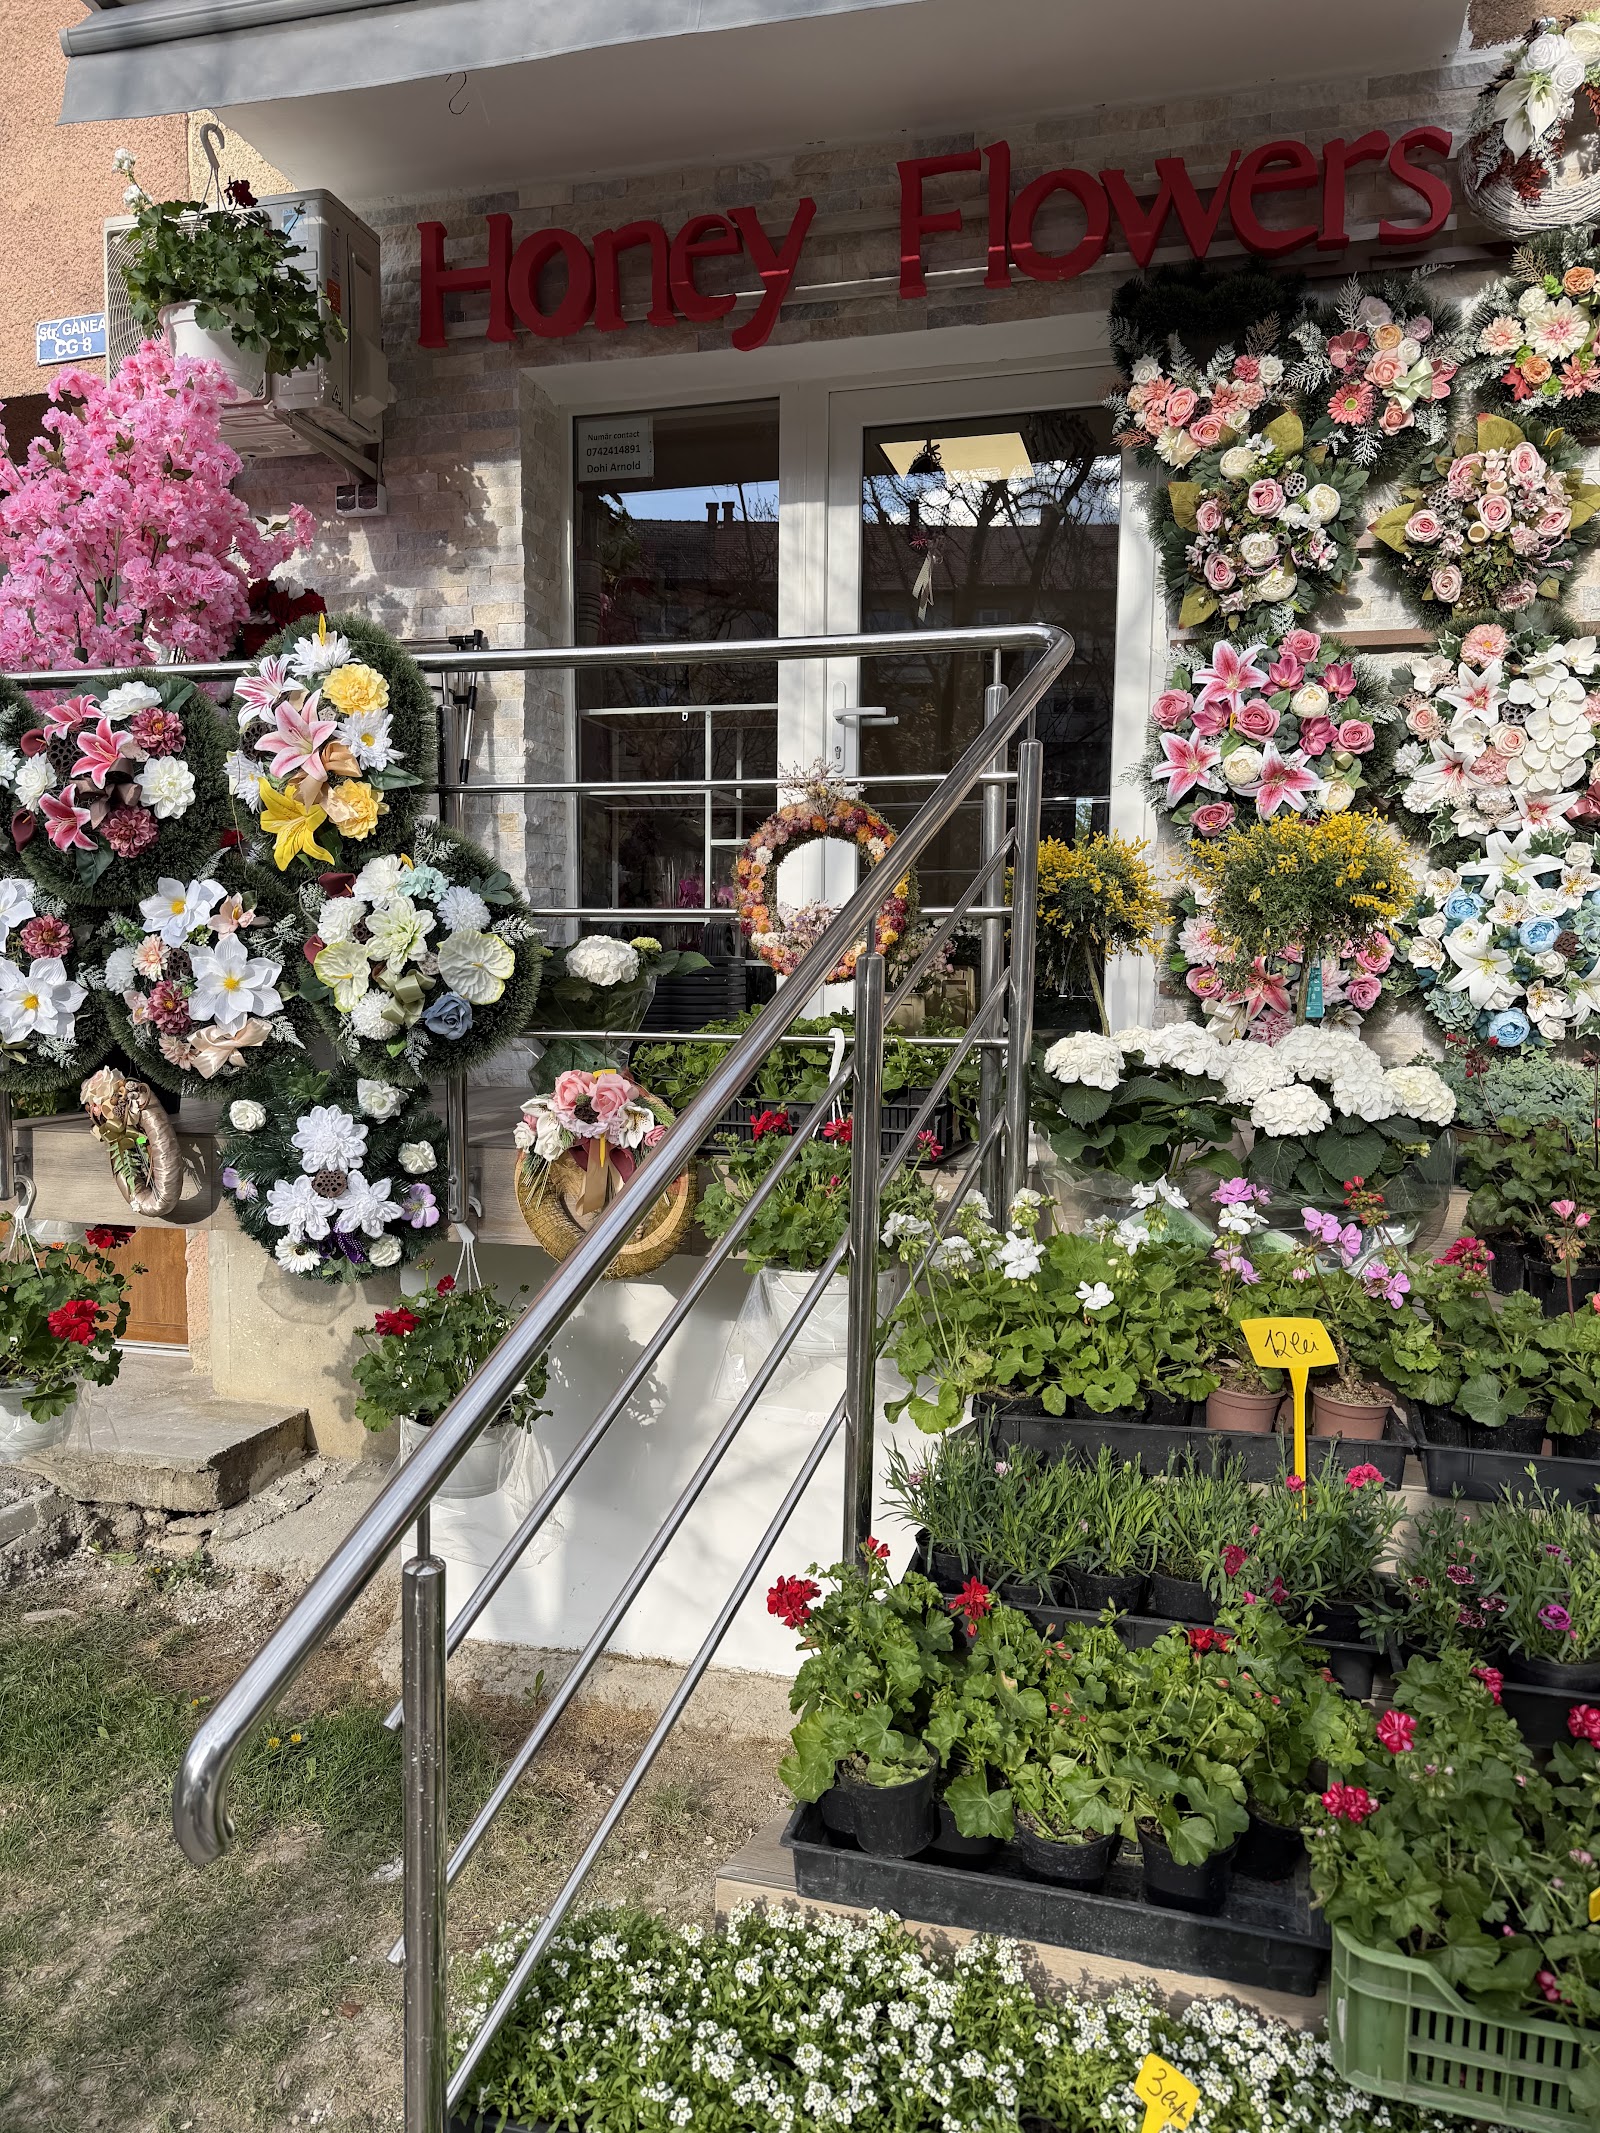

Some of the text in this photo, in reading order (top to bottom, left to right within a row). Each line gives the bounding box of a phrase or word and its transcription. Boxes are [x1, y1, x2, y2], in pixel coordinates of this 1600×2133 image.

[417, 126, 1453, 352] Honey Flowers
[39, 325, 59, 341] Str.
[55, 336, 92, 357] CG 8
[613, 430, 640, 439] contact
[586, 444, 641, 457] 0742414891
[587, 460, 641, 473] Dohi Arnold
